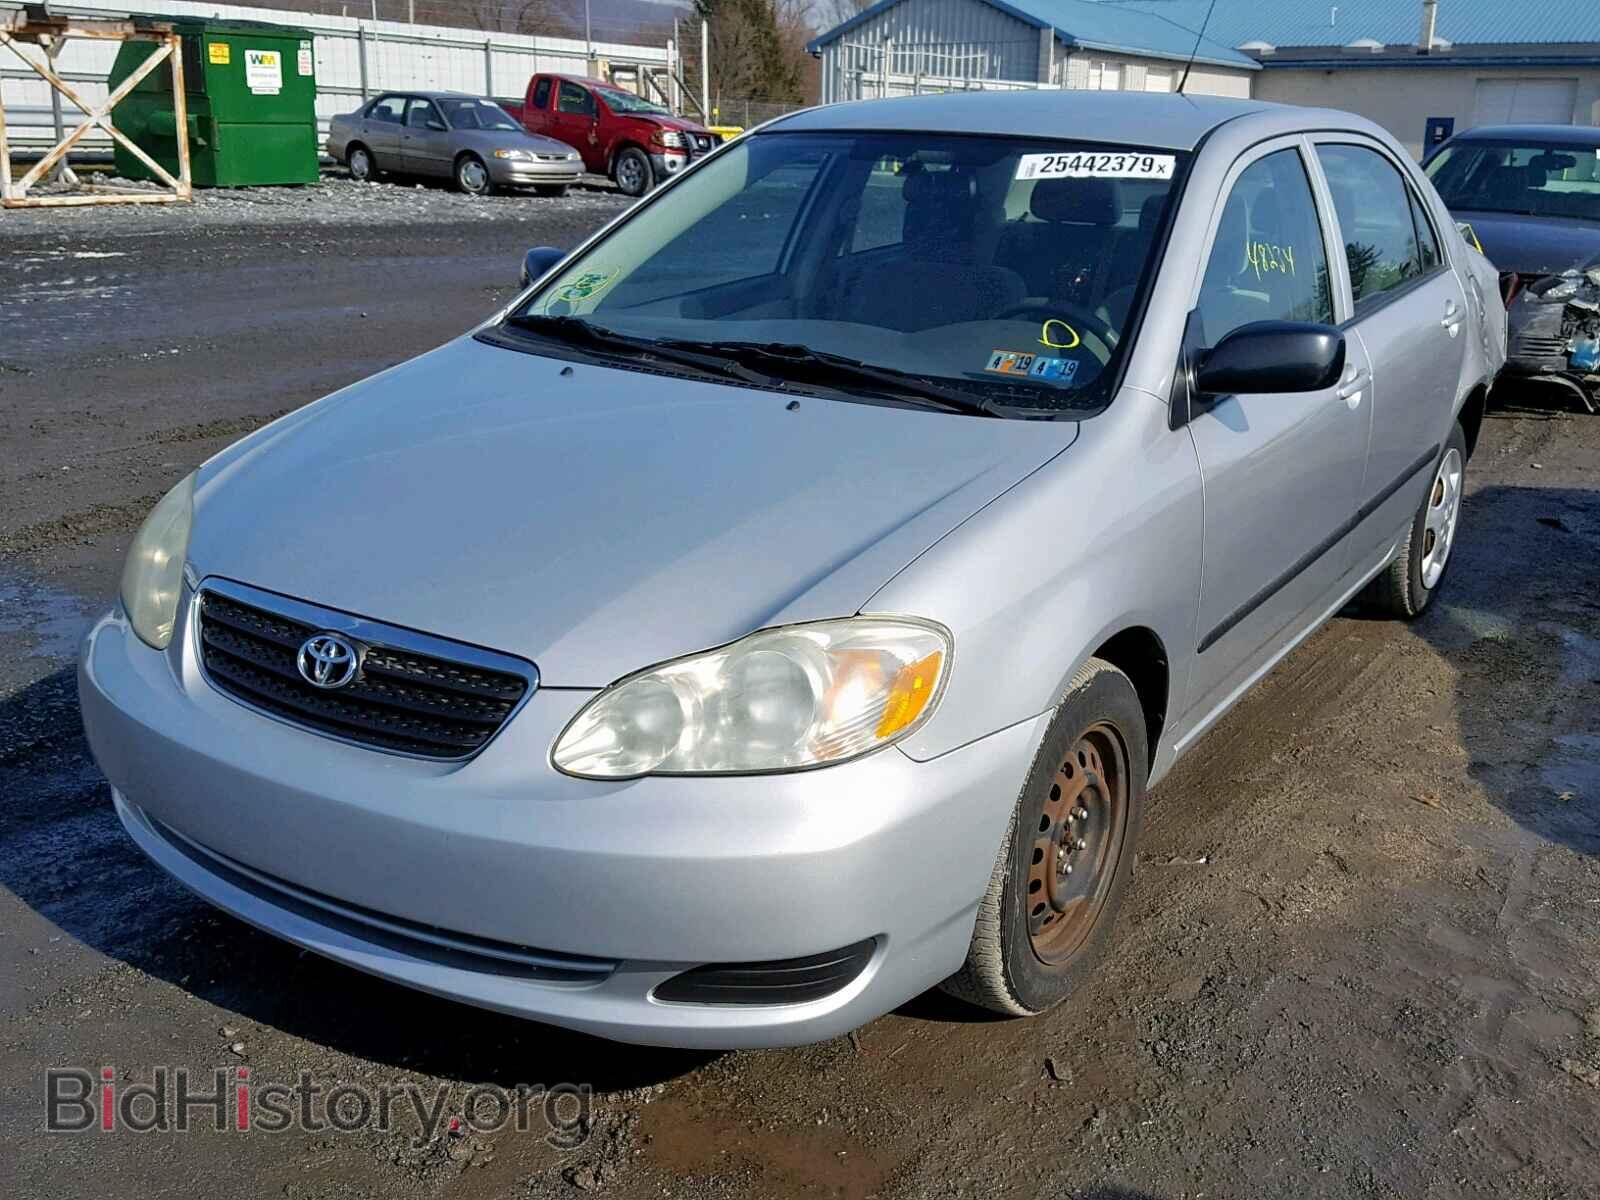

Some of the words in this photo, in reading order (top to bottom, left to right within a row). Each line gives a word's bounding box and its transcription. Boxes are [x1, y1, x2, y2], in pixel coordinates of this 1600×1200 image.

[1040, 155, 1154, 173] 25442379
[992, 356, 1003, 369] 4
[1015, 356, 1032, 370] 19
[1037, 361, 1047, 375] 4
[1059, 362, 1076, 377] 19
